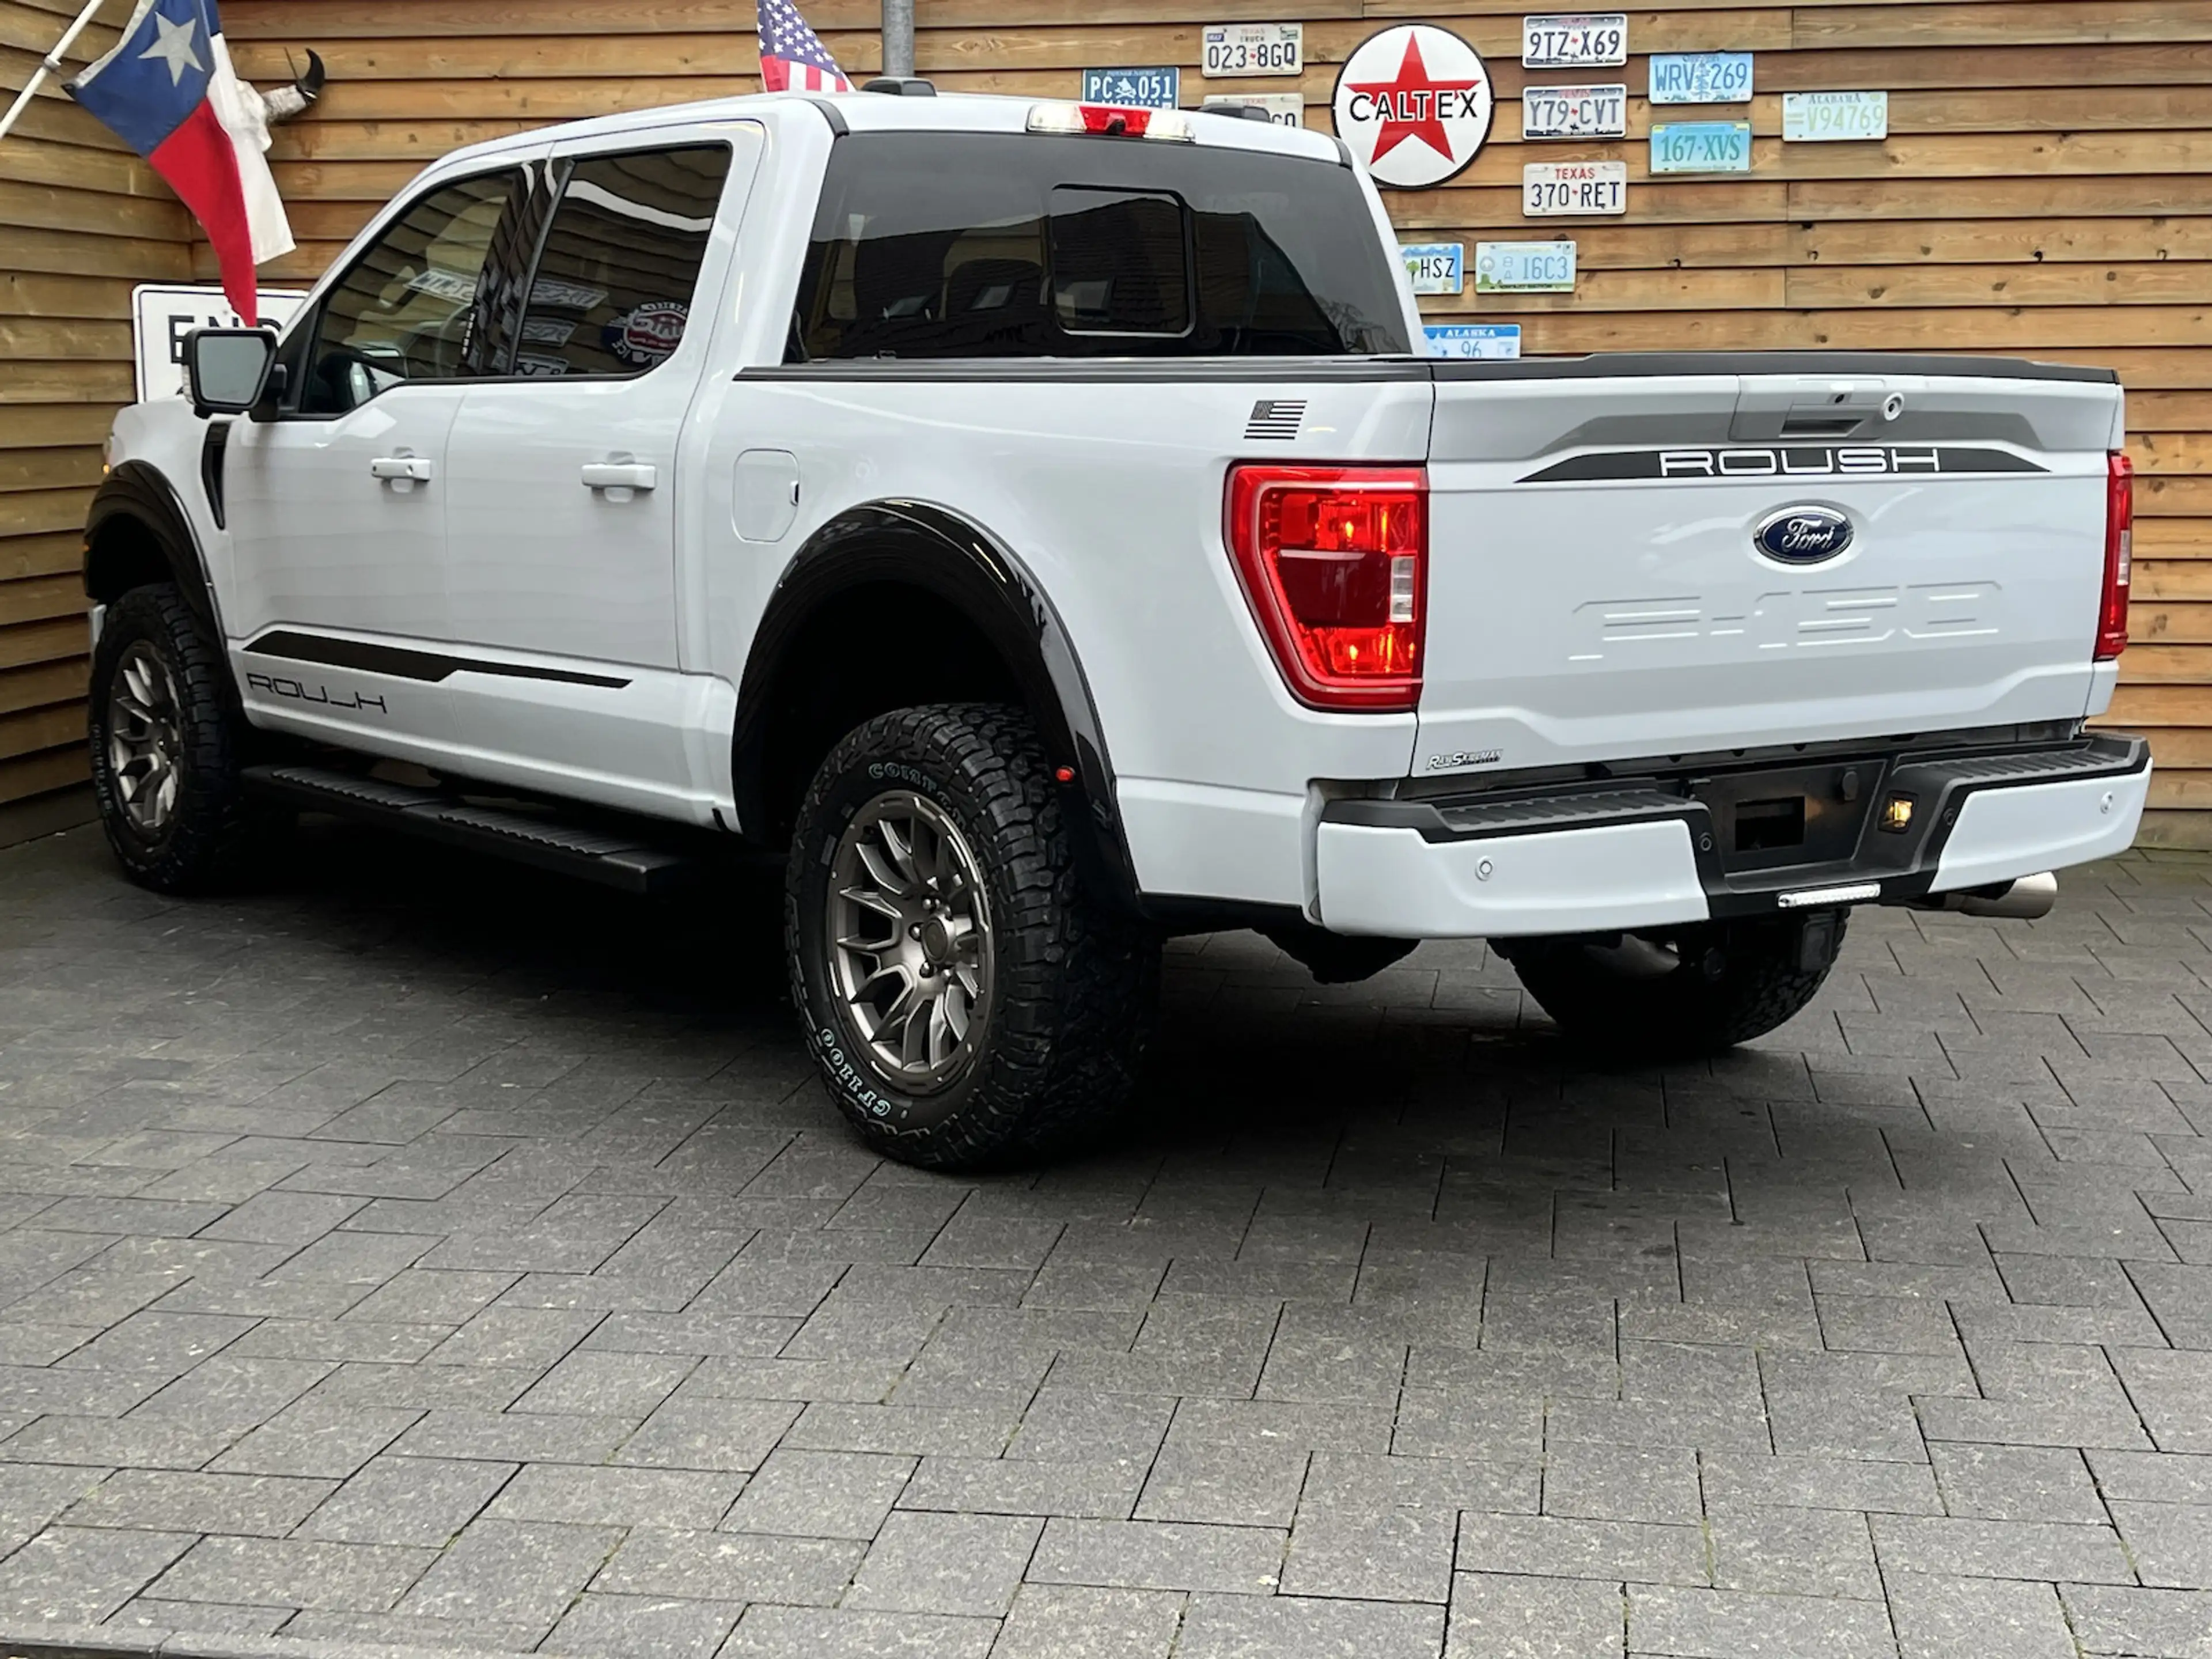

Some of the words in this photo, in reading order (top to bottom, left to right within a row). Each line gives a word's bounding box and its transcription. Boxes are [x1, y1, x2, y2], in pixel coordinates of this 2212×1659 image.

[1349, 91, 1478, 122] CALTEX
[1808, 93, 1862, 105] ALABAMA
[1555, 167, 1596, 180] TEXAS
[1420, 258, 1456, 279] HSZ
[1446, 328, 1496, 338] ALASKA
[1658, 448, 1940, 477] ROUSH
[1782, 518, 1835, 552] Ford
